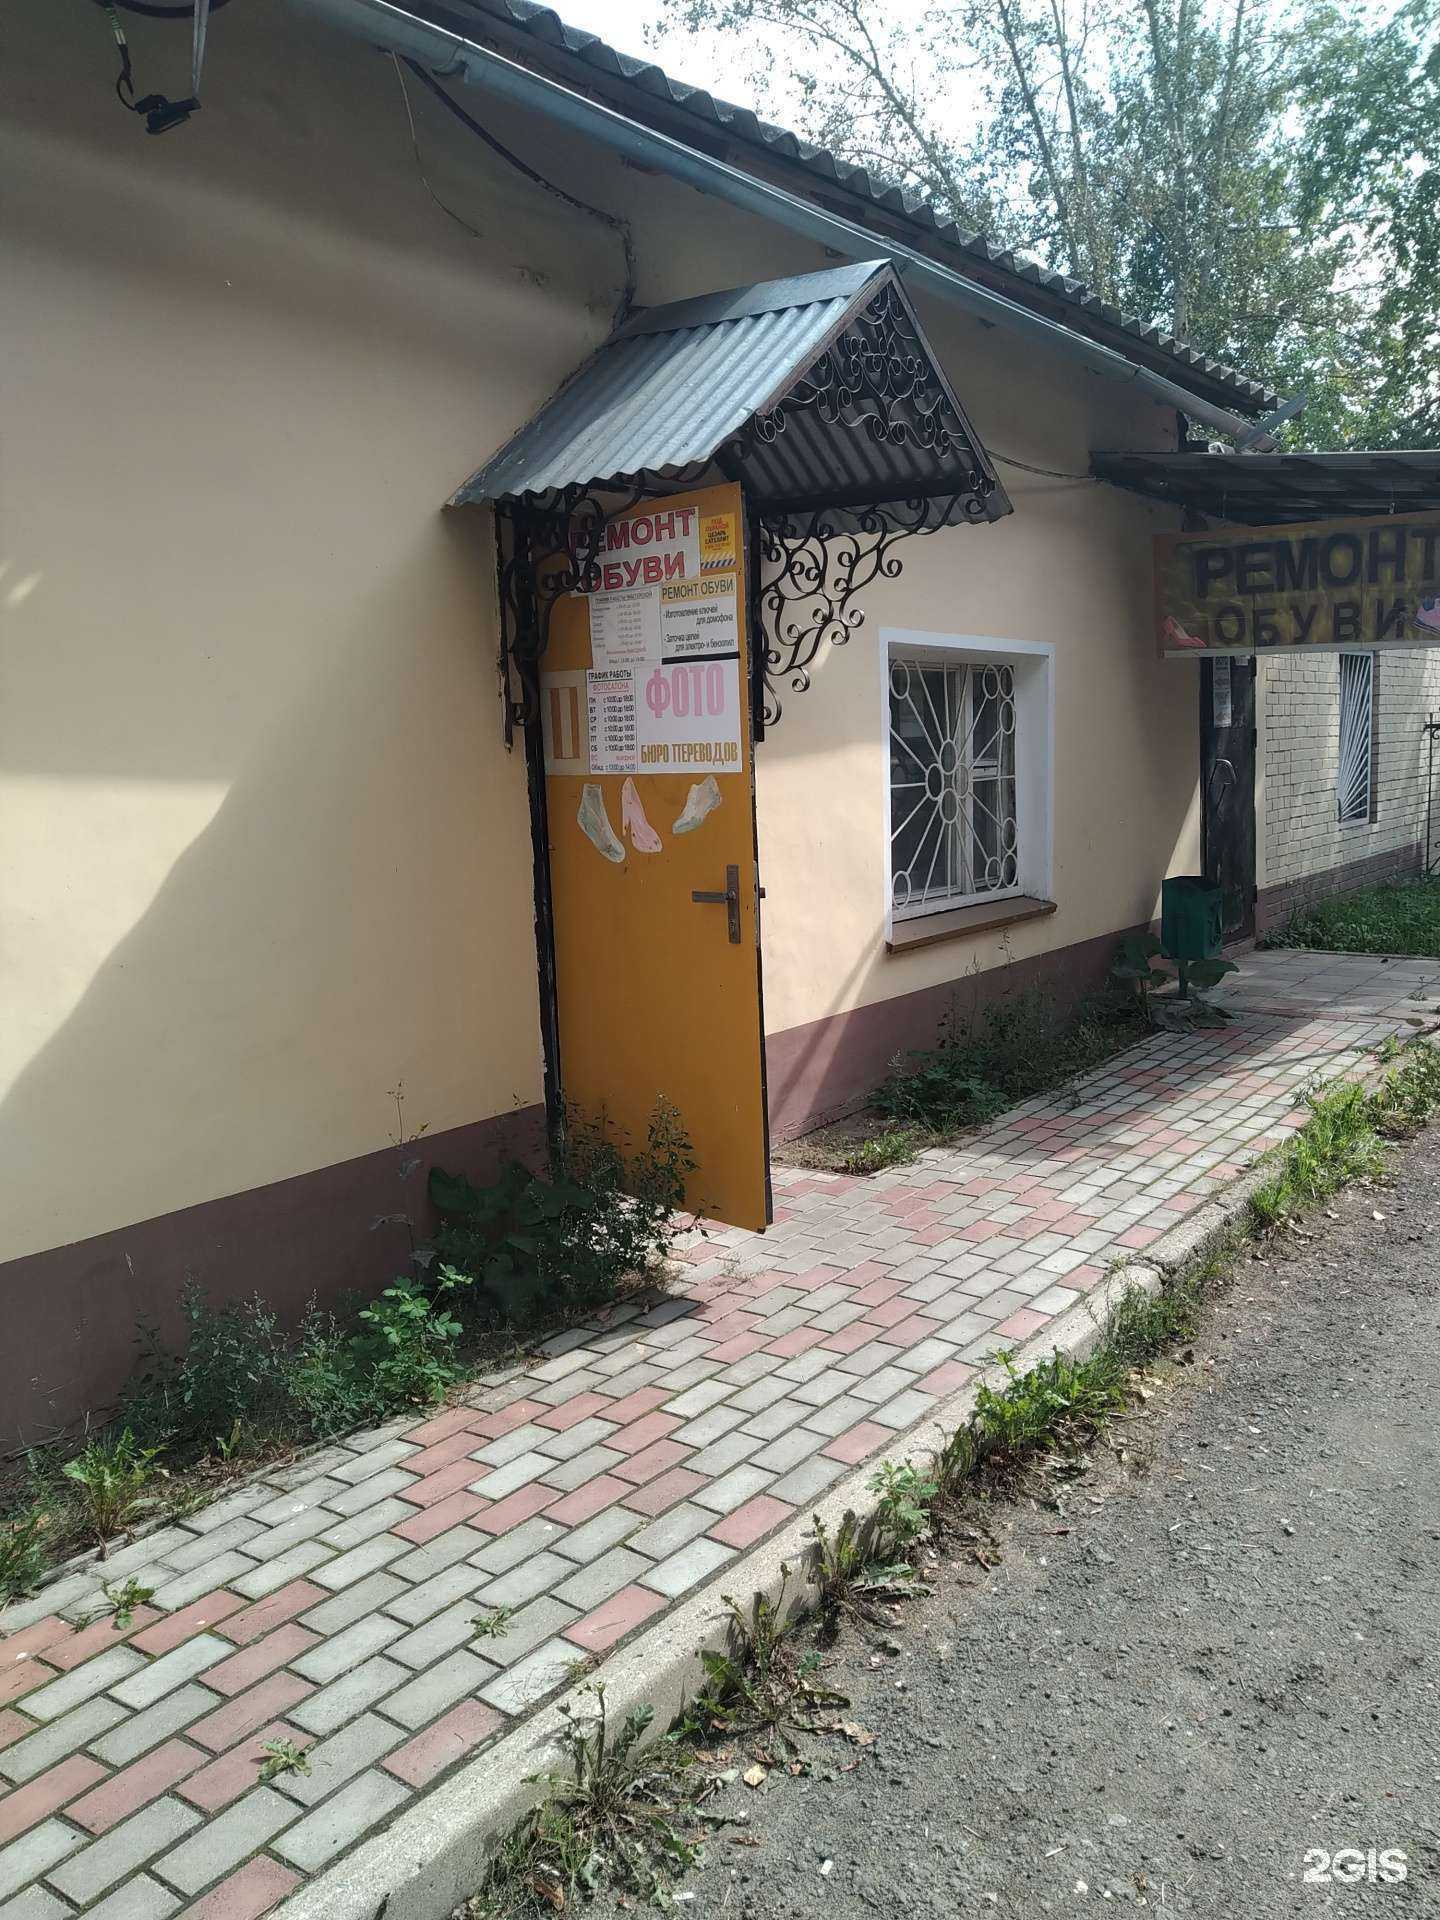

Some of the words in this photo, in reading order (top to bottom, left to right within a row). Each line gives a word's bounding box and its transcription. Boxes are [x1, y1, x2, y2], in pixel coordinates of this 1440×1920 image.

[1195, 527, 1440, 598] РЕМОНТ
[662, 583, 699, 600] РЕМОНТ
[700, 579, 734, 595] ОБУВИ
[1215, 598, 1408, 646] ОБУВИ
[589, 671, 609, 681] ГРАФИК
[609, 669, 632, 679] РАБОТЫ
[645, 663, 726, 719] ФОТО
[641, 743, 669, 764] БЮРО
[671, 741, 738, 766] ПЕРЕВОДОВ
